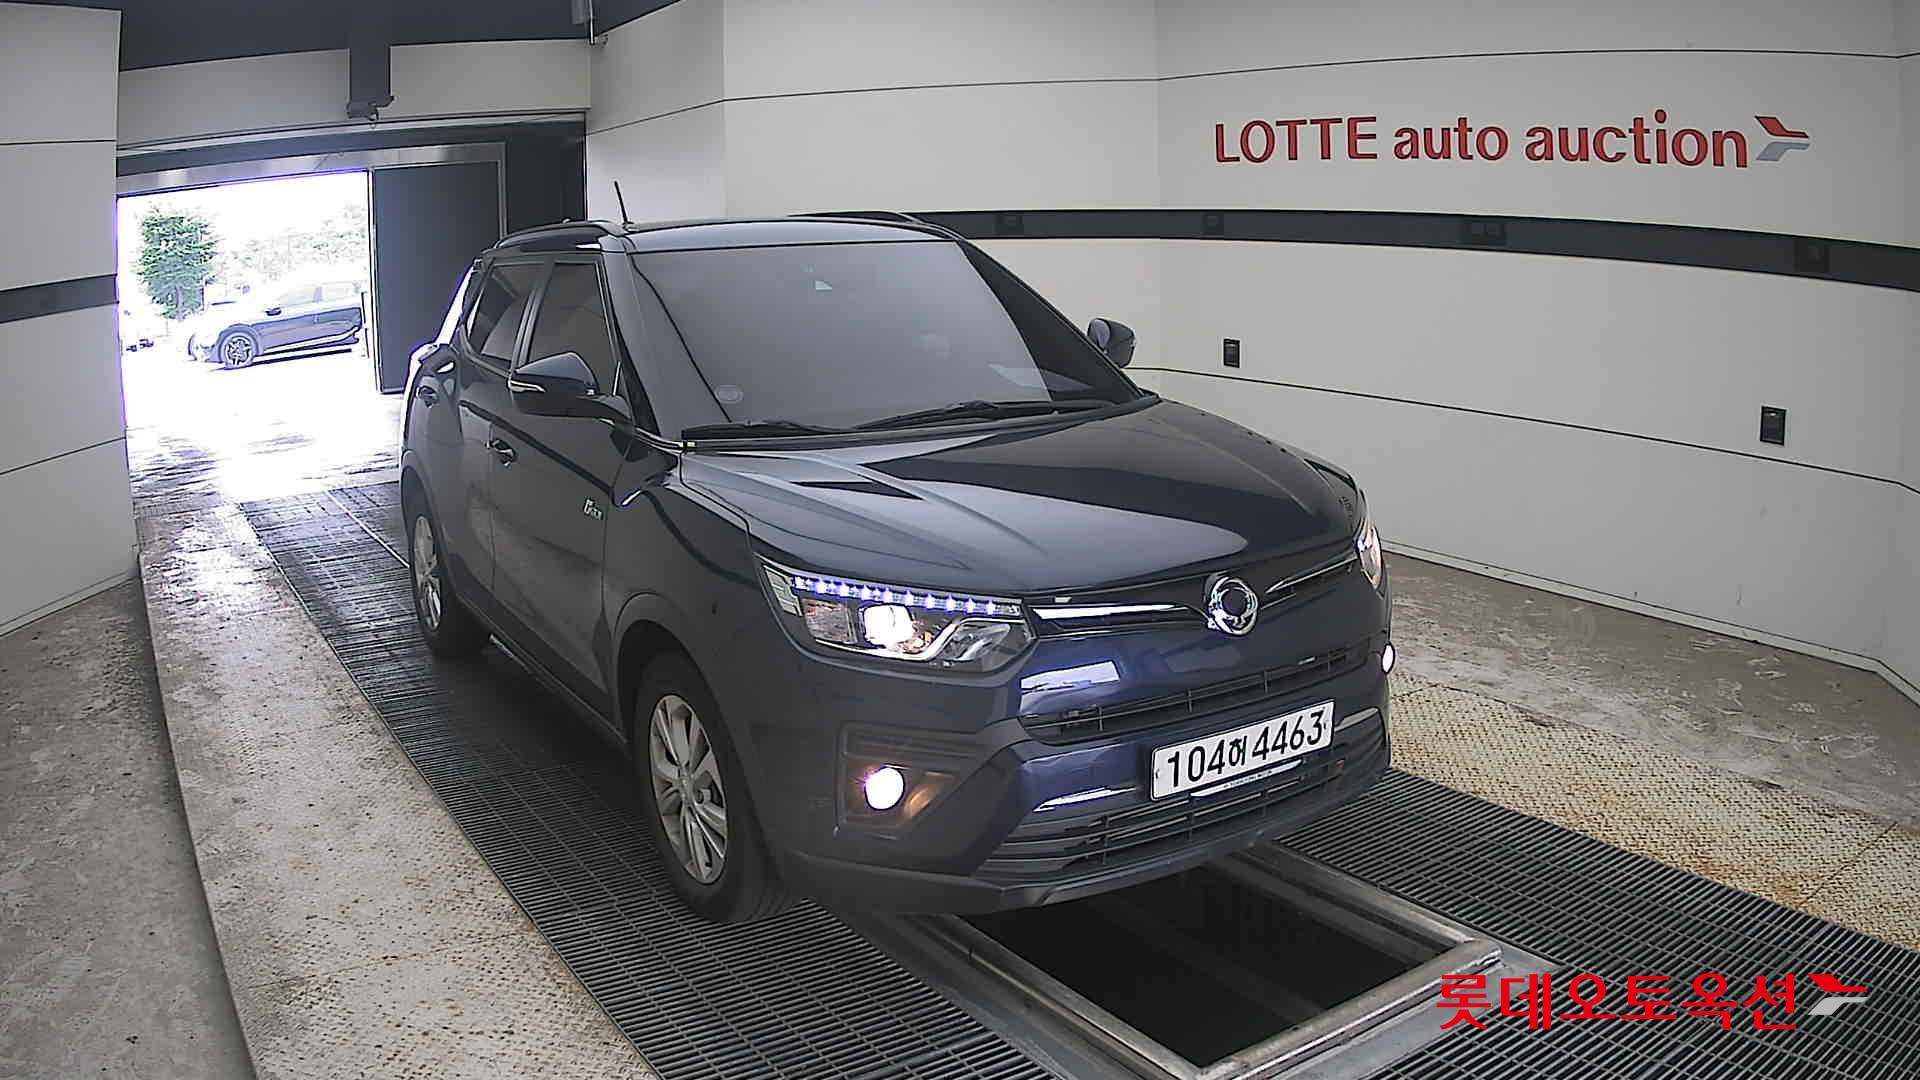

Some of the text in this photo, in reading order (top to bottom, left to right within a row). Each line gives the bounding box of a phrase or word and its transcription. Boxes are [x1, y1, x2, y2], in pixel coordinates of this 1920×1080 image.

[1215, 109, 1748, 168] LOTTE auto auction
